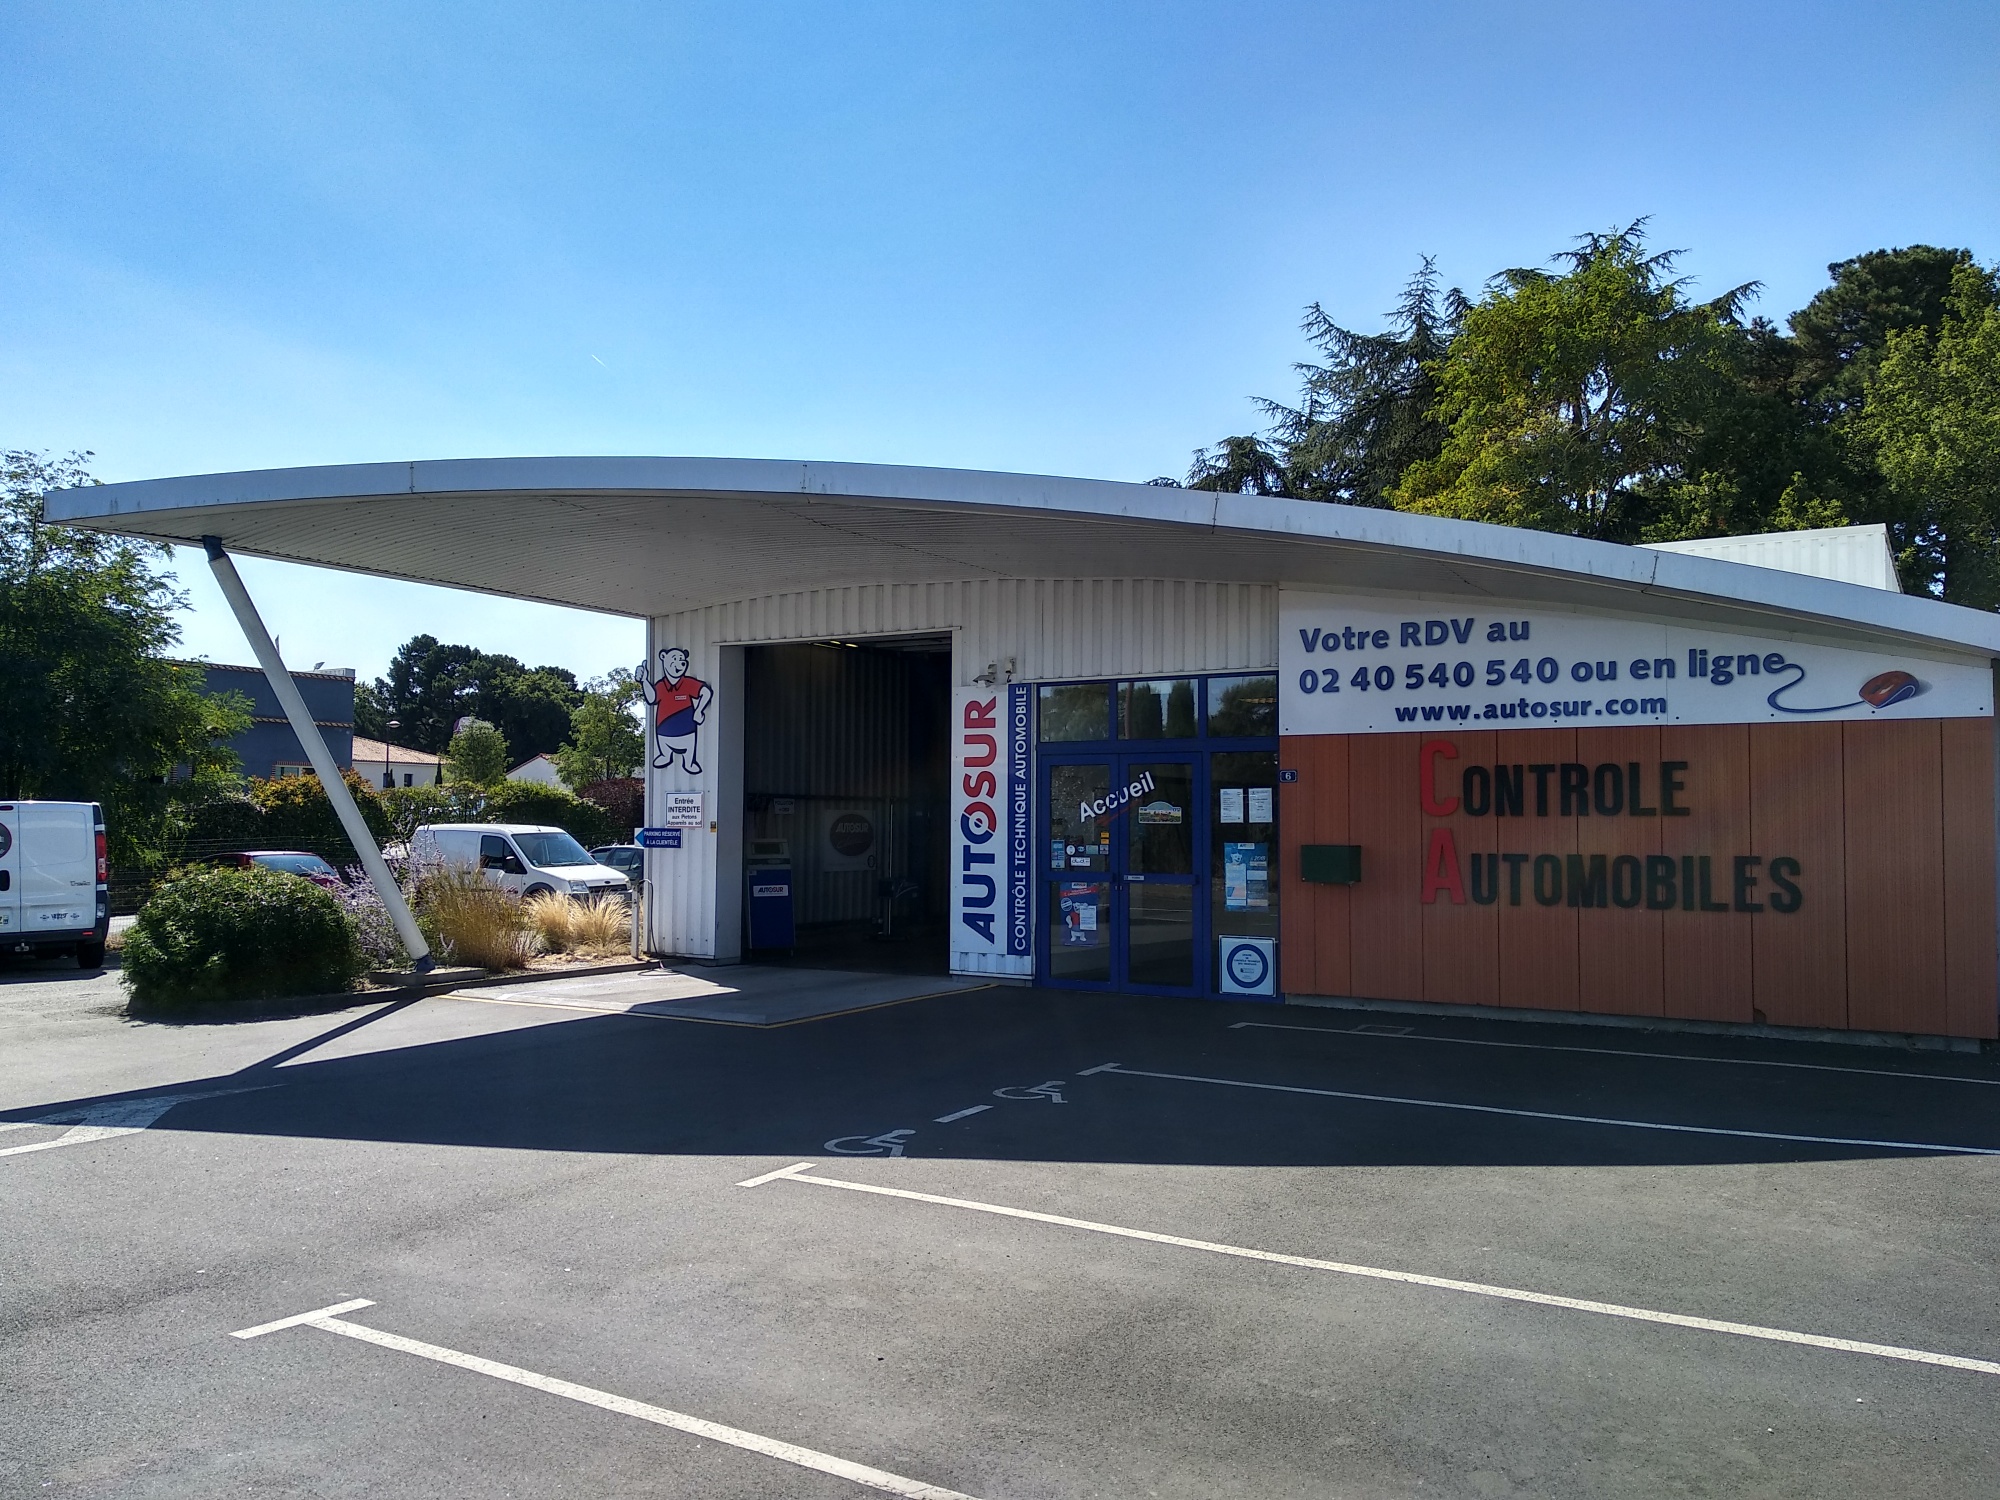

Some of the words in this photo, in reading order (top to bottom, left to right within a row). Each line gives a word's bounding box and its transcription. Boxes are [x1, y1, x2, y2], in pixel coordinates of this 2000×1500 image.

[1299, 626, 1389, 652] Votre
[1400, 617, 1475, 648] RDV
[1486, 620, 1530, 642] au
[1299, 669, 1340, 694] 02
[1350, 665, 1395, 691] 40
[1405, 661, 1475, 689] 540
[1486, 656, 1559, 686] 540
[1571, 661, 1617, 682] ou
[1629, 657, 1676, 680] en
[1688, 648, 1785, 686] ligne
[1014, 686, 1027, 780] AUTOMOBILE
[1394, 697, 1667, 722] www.autosur.com
[1079, 770, 1156, 823] Accueil
[1285, 771, 1292, 781] 6
[1419, 739, 1691, 817] CONTROLE
[835, 822, 869, 833] AUTOSUR
[960, 696, 997, 945] AUTOSUR
[1014, 783, 1027, 866] TECHNIQUE
[758, 886, 784, 894] AUTOSUR
[1421, 828, 1803, 914] AUTOMOBILES
[1011, 870, 1026, 951] CONTRÔLE
